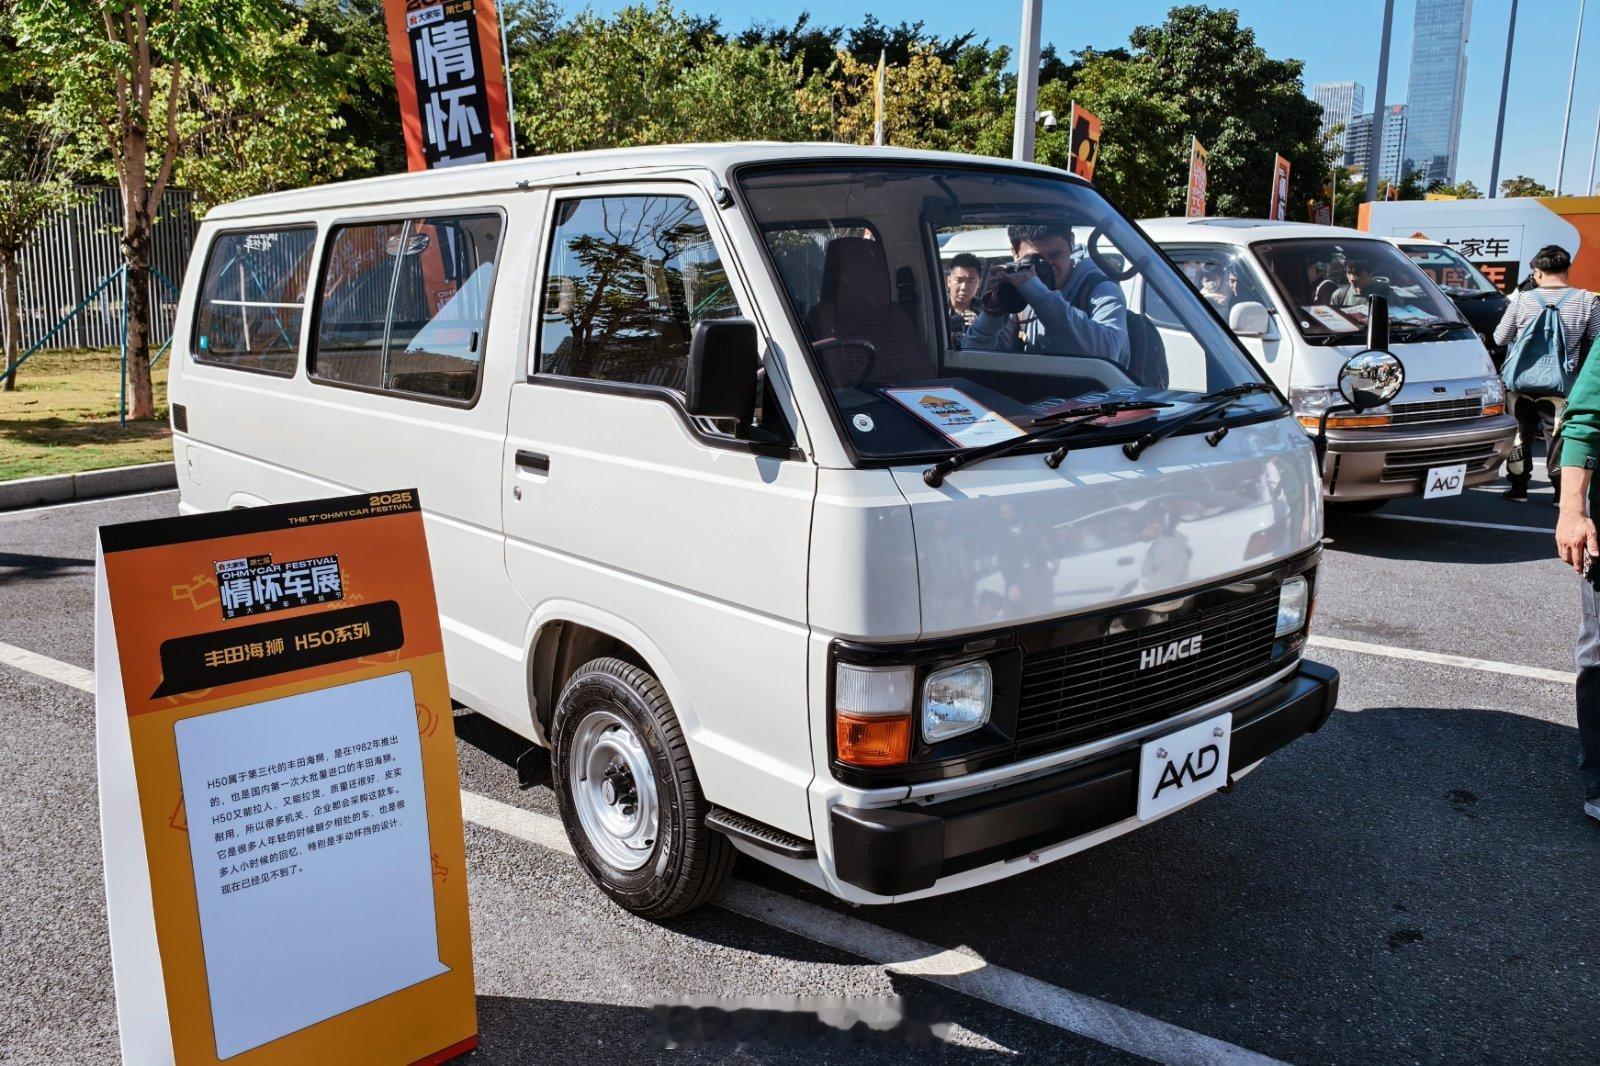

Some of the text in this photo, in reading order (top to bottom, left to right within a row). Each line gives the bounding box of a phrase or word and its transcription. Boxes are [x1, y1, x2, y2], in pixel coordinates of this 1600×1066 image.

[416, 20, 487, 168] 情怀
[288, 516, 308, 524] THE
[320, 508, 369, 520] OHMYCAR
[371, 502, 413, 514] FESTIVAL
[370, 492, 412, 507] 2025
[222, 557, 337, 580] OHMYCAR FESTIVAL
[221, 564, 340, 610] 情怀车展
[204, 621, 371, 668] 丰田海狮 H50系列
[1139, 634, 1203, 670] HIACE
